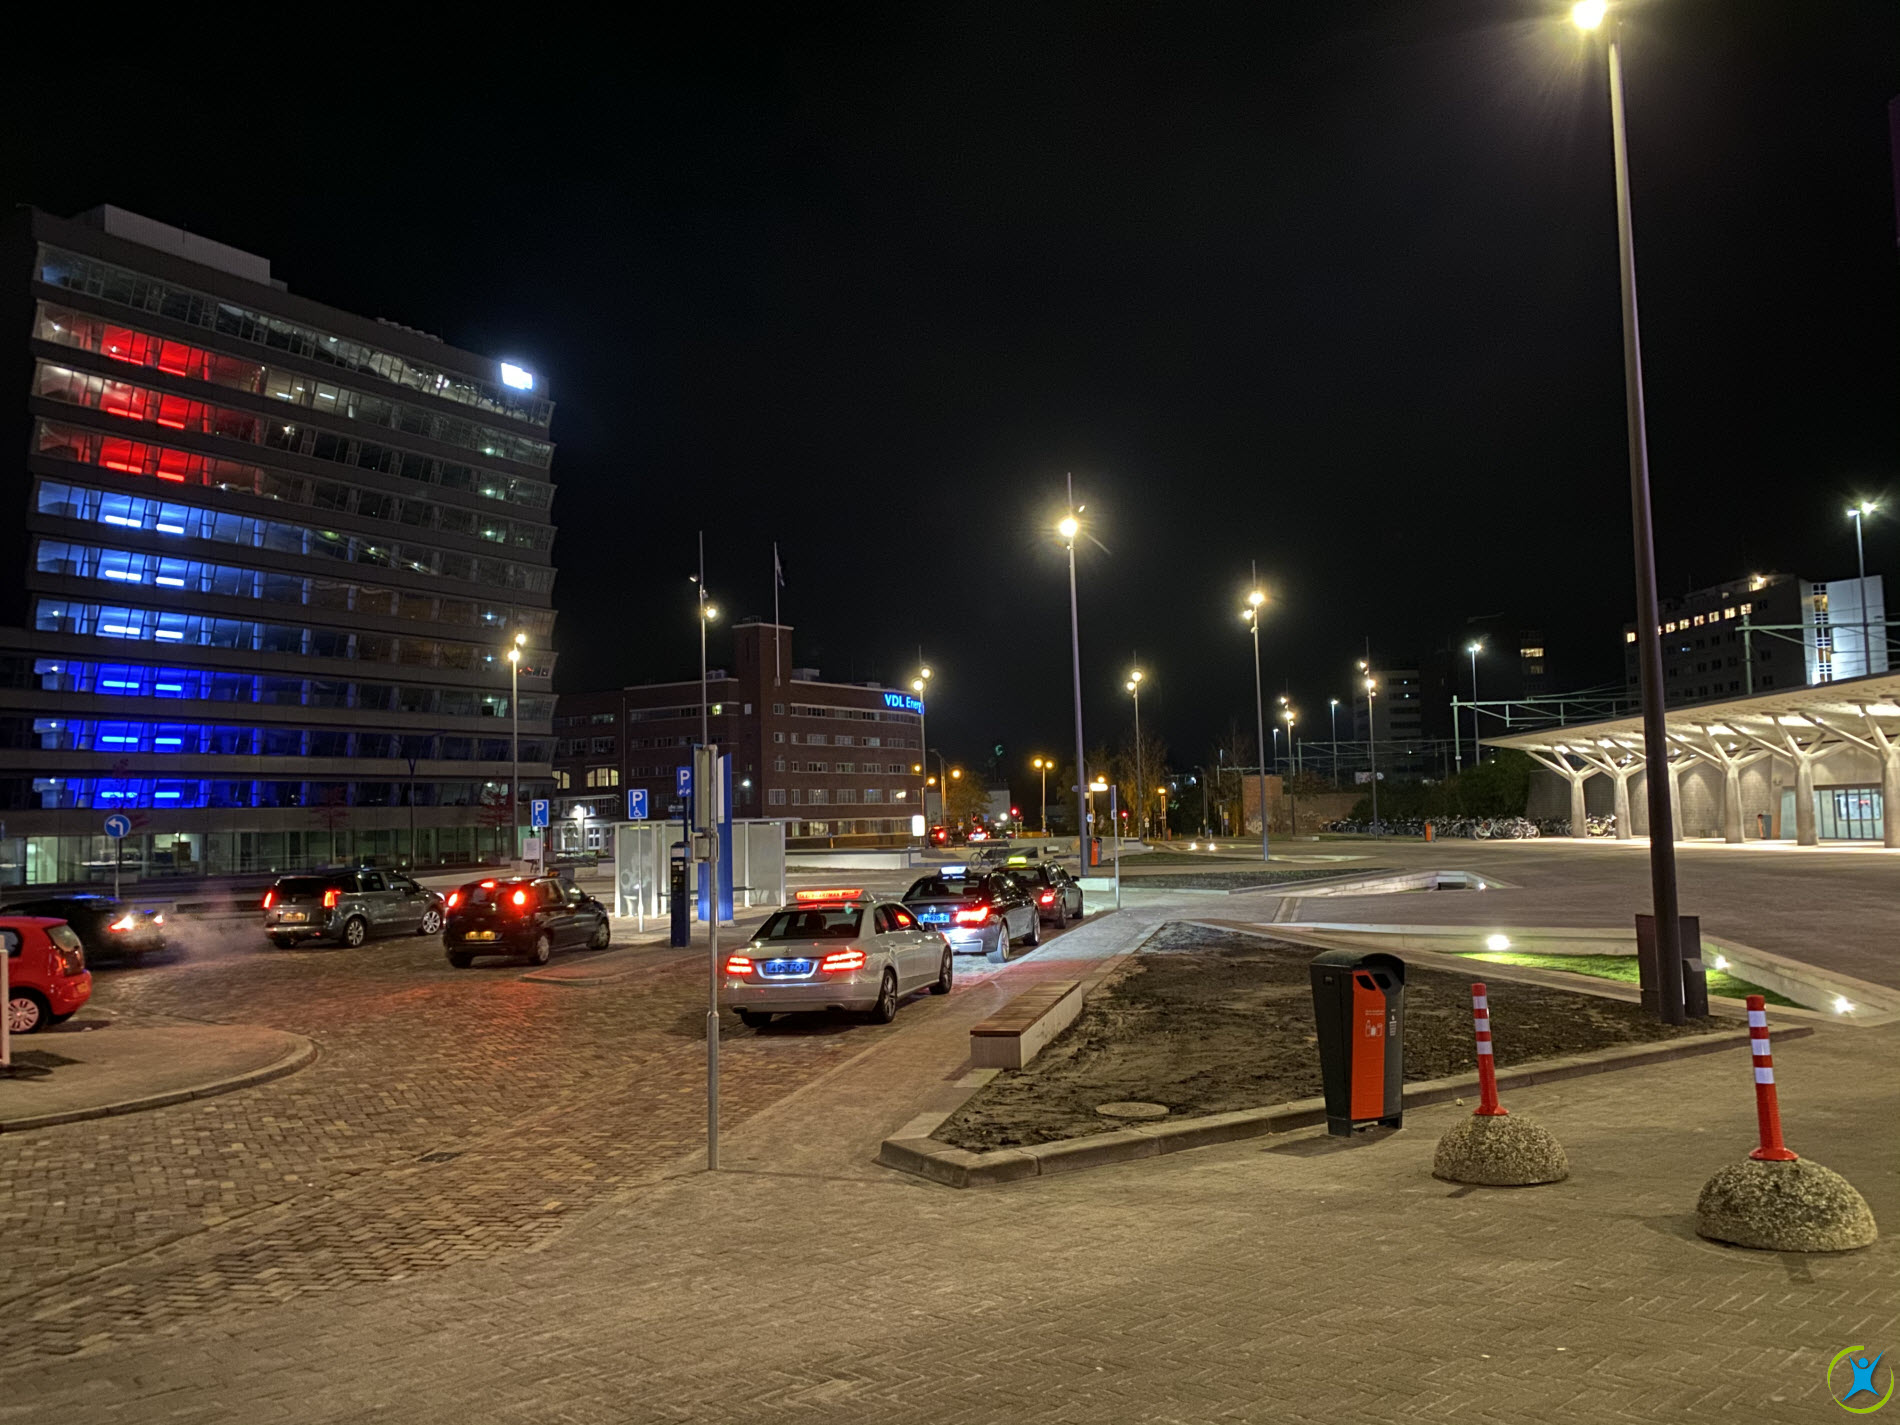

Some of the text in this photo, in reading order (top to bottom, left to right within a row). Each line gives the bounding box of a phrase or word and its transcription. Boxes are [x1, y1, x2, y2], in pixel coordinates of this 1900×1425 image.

[884, 693, 924, 714] VDL Energ
[680, 770, 690, 785] P
[632, 791, 643, 807] P
[535, 802, 545, 816] P
